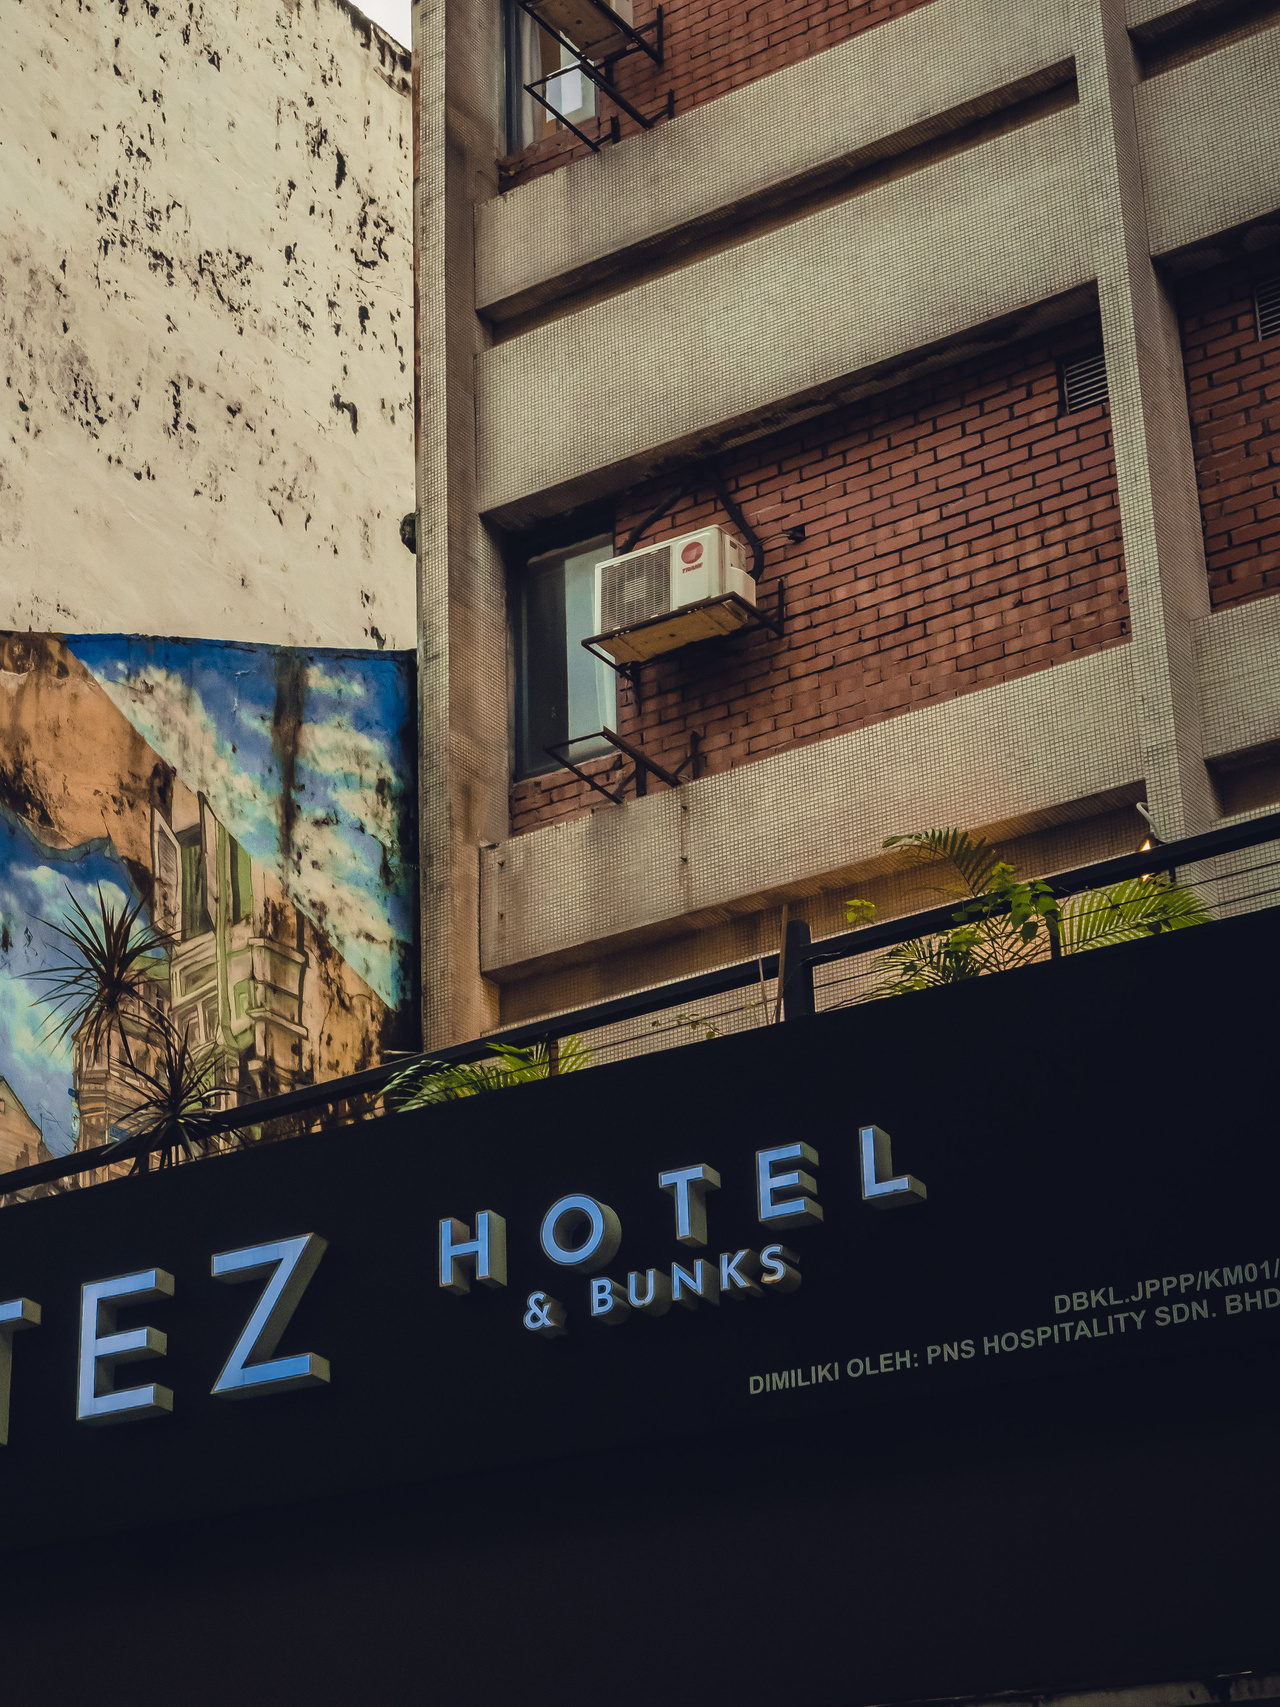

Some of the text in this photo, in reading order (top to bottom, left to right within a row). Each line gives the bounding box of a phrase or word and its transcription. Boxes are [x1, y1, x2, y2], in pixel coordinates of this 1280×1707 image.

[439, 1124, 927, 1295] HOTEL
[523, 1243, 799, 1334] & BUNKS
[749, 1287, 1280, 1395] DIMILIKI OLEH: PNS HOSPITALITY SDN. BHD
